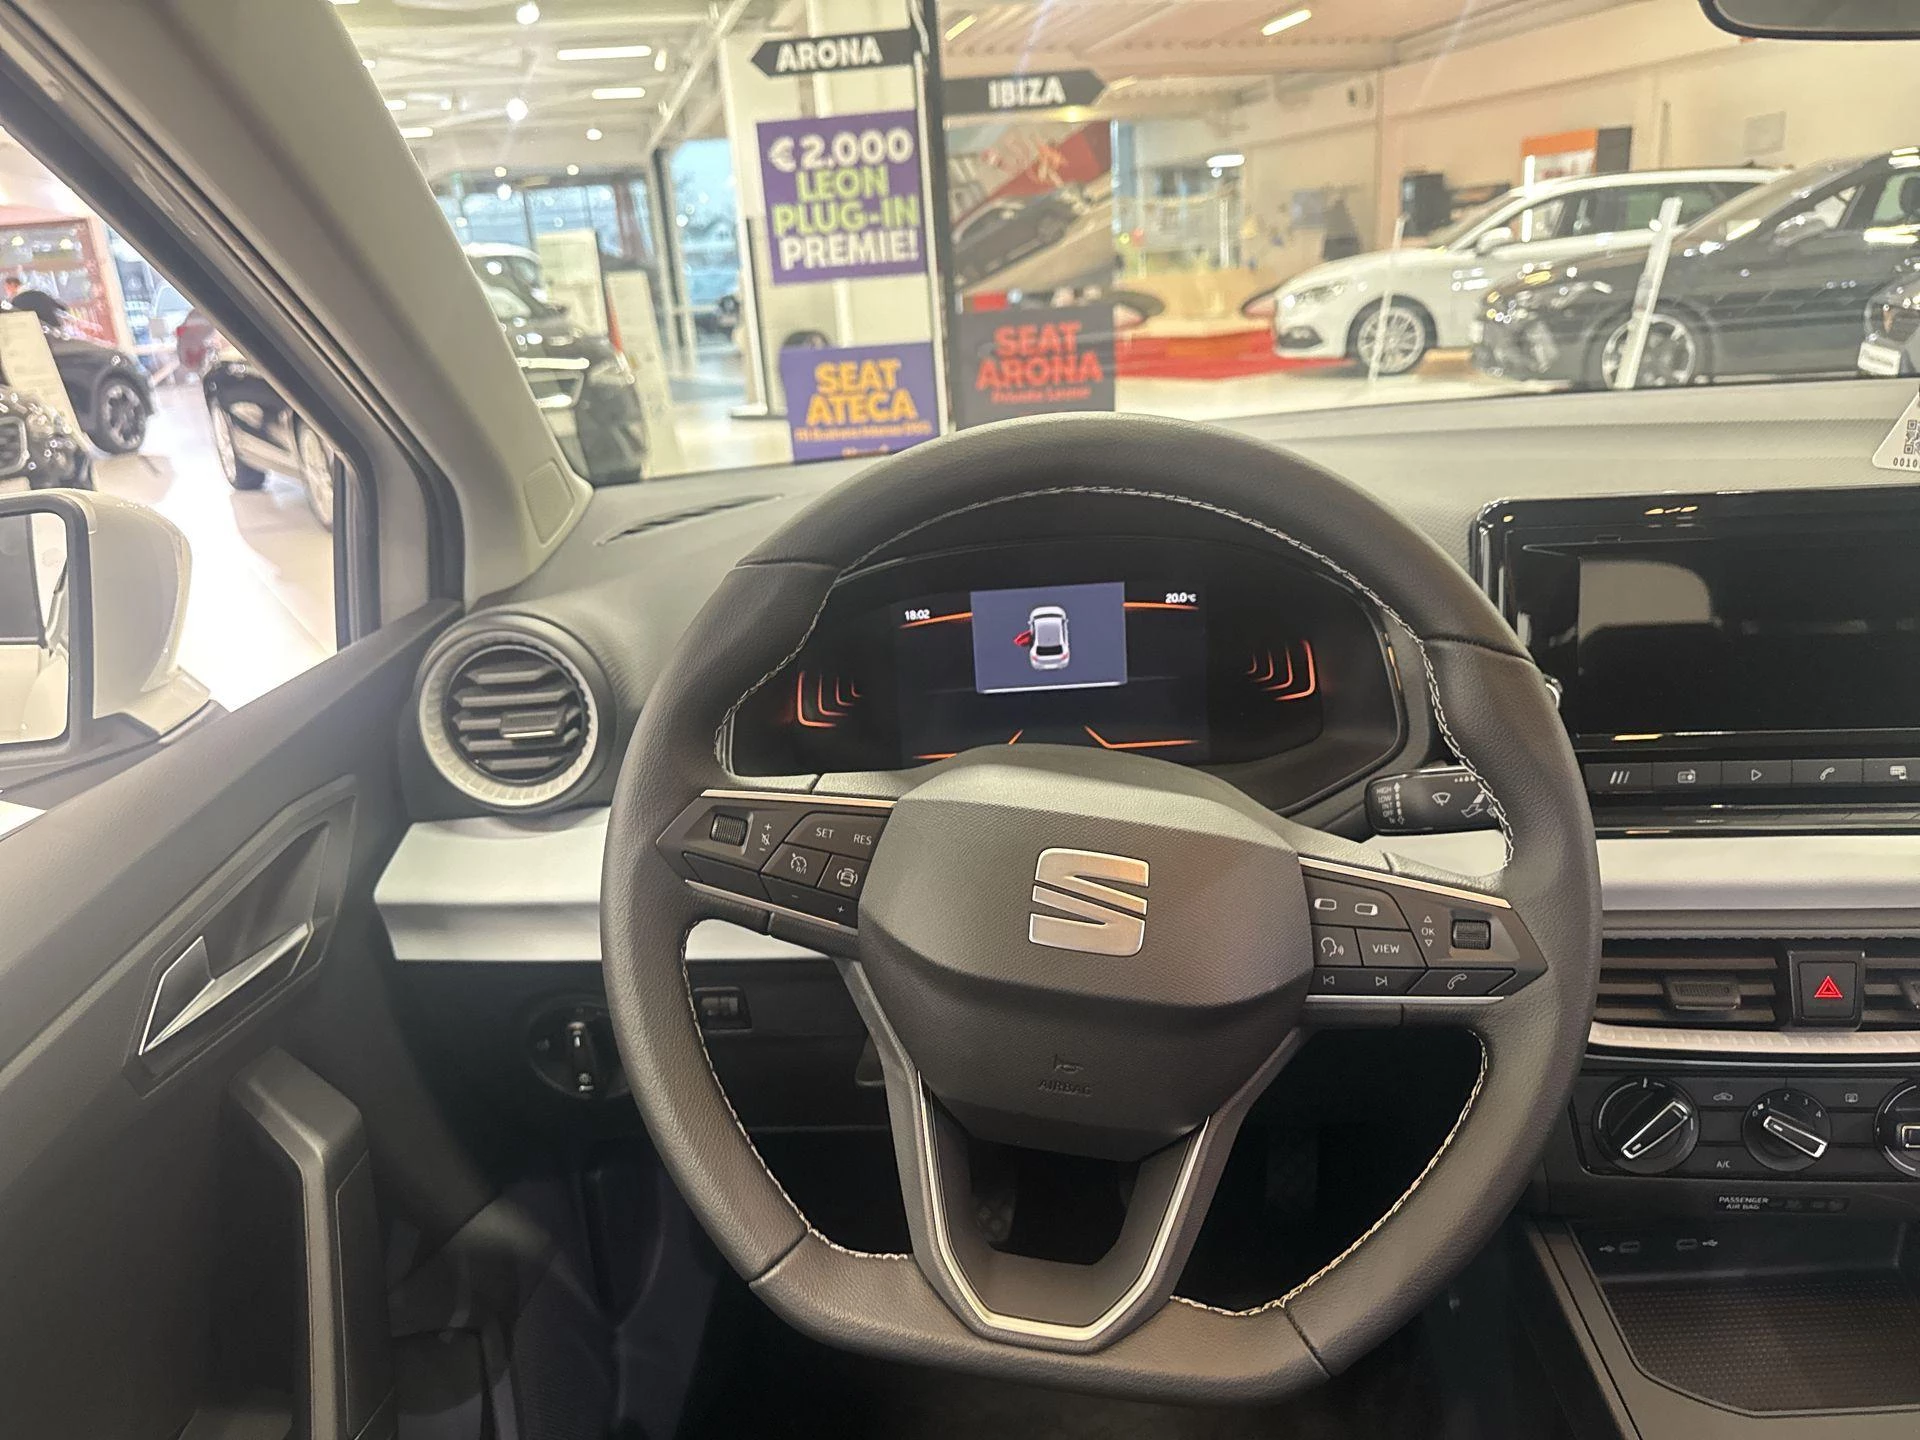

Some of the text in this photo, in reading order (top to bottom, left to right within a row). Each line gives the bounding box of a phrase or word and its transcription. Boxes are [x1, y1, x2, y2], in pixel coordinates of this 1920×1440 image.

[775, 36, 883, 73] ARONA
[987, 75, 1067, 109] IBIZA
[796, 163, 890, 202] LEON
[772, 193, 920, 237] PLUG-IN
[778, 228, 920, 272] PREMIE!
[994, 321, 1082, 357] SEAT
[815, 358, 901, 393] SEAT
[975, 351, 1104, 391] ARONA
[806, 389, 918, 427] ATECA
[816, 827, 834, 839] SET
[853, 833, 872, 846] RES
[1372, 944, 1400, 954] VIEW
[1421, 927, 1435, 936] OK
[1716, 1160, 1731, 1169] A/C
[1718, 1196, 1769, 1204] PASSENGER
